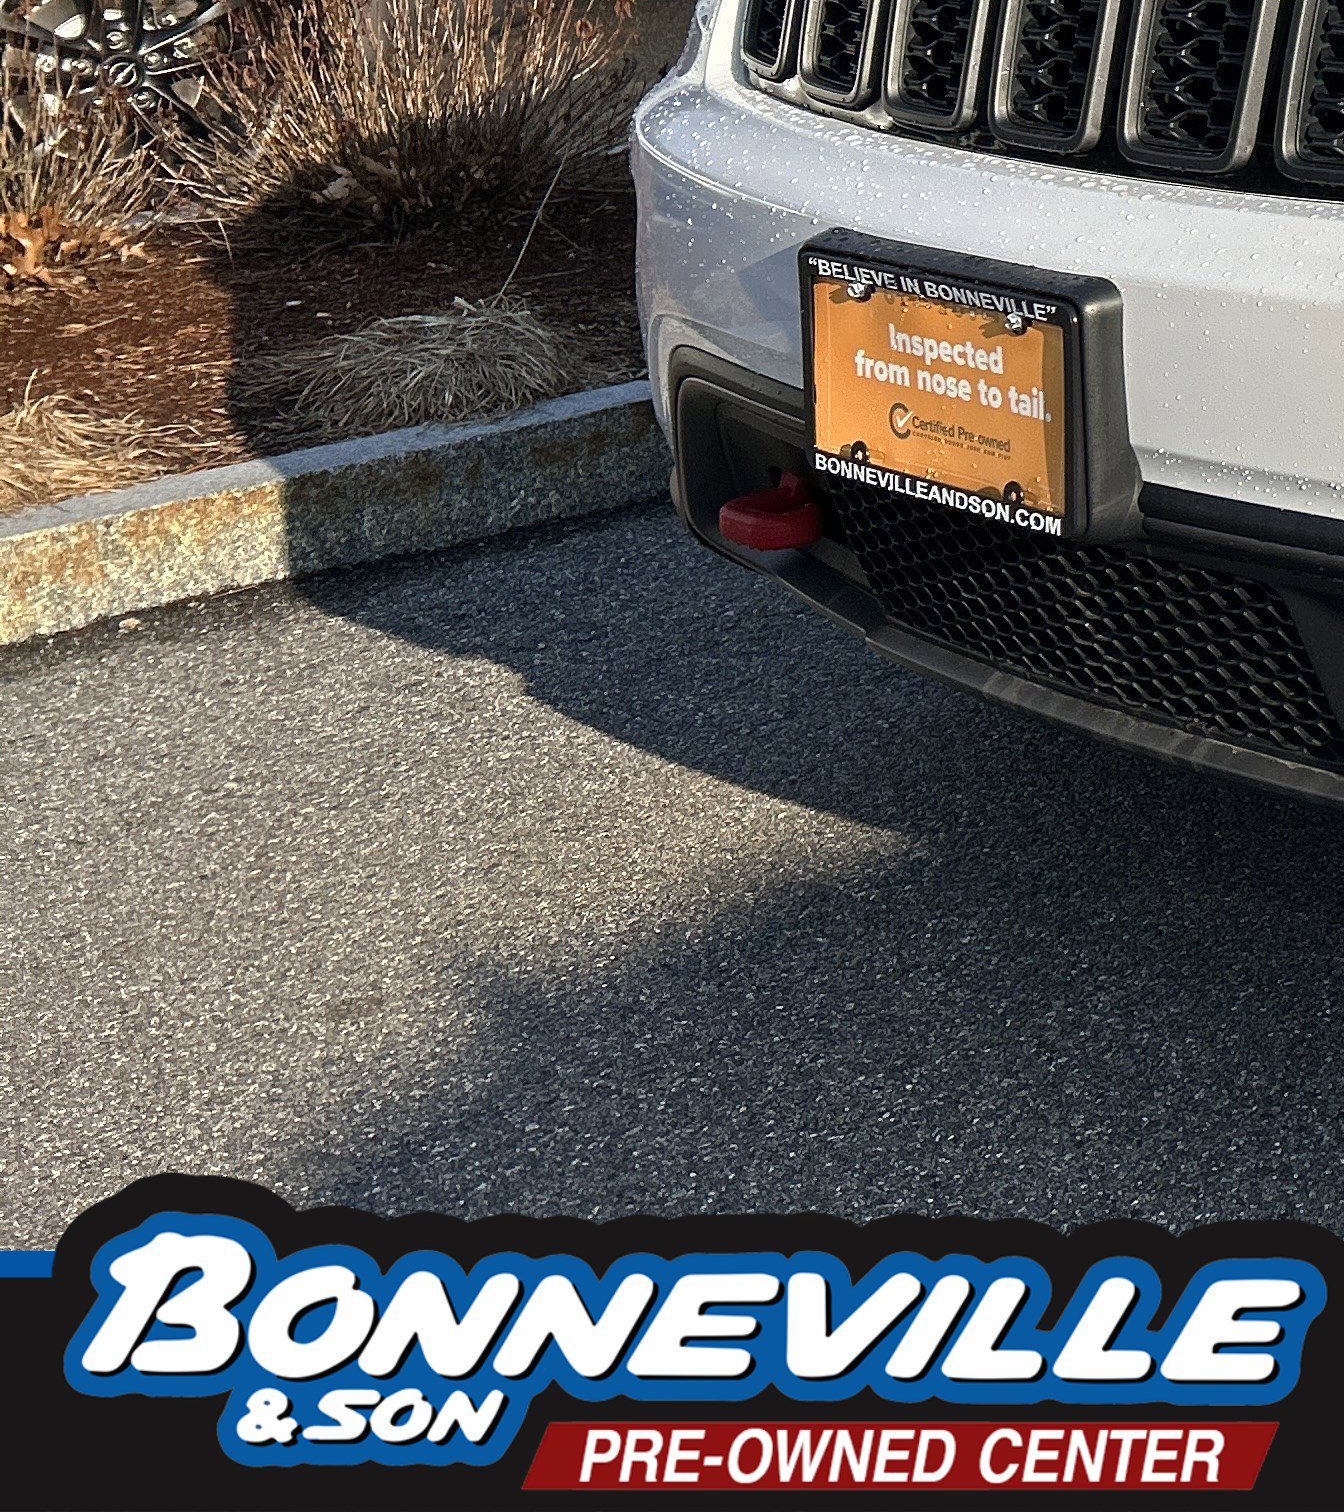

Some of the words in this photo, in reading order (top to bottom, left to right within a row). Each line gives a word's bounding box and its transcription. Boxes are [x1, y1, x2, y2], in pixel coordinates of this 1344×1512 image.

[900, 277, 919, 294] IN
[888, 323, 1004, 375] Inspected
[854, 349, 910, 387] from
[917, 369, 972, 402] nose
[978, 378, 1003, 409] to
[1008, 385, 1052, 422] tail.
[912, 415, 955, 438] Certified
[958, 426, 1011, 453] Pre-owned
[815, 452, 1062, 537] BONNEVILLEANDSON.COM
